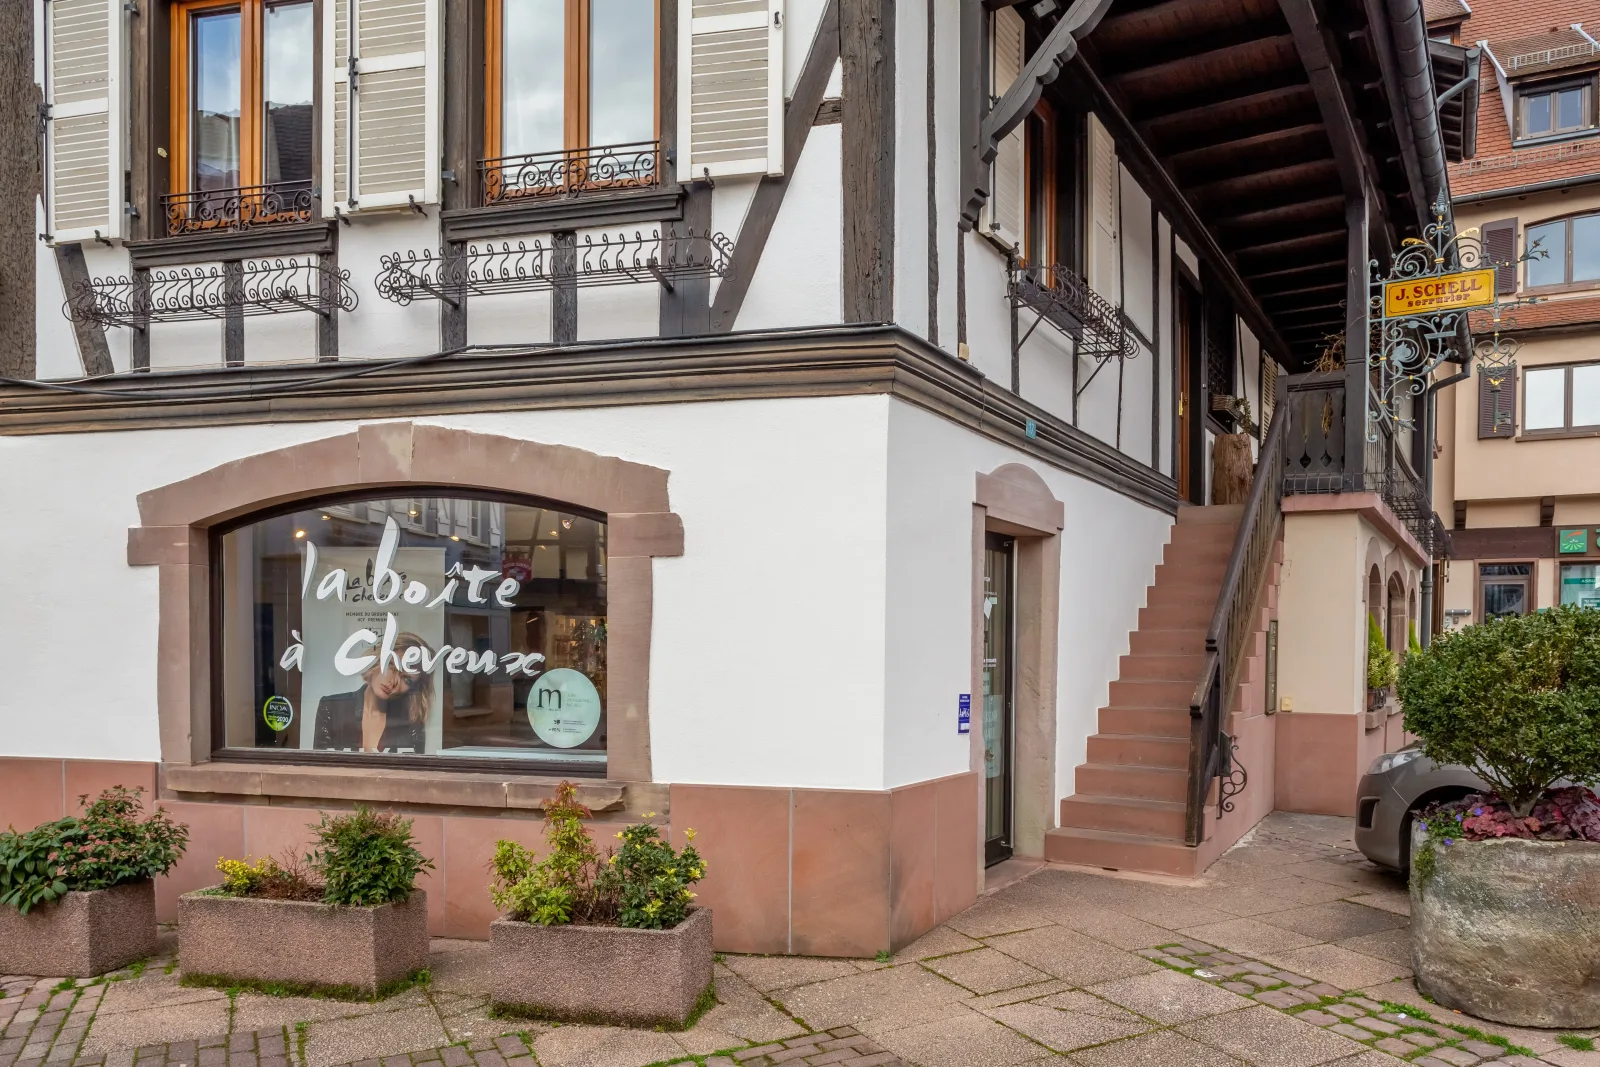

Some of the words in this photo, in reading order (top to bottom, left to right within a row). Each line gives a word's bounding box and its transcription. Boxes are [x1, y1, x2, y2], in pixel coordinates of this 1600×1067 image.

[1395, 288, 1409, 301] J.
[1413, 278, 1482, 299] SCHELL
[1407, 293, 1471, 308] serrurier
[302, 540, 347, 603] la
[373, 515, 521, 610] boîte
[279, 629, 305, 674] à
